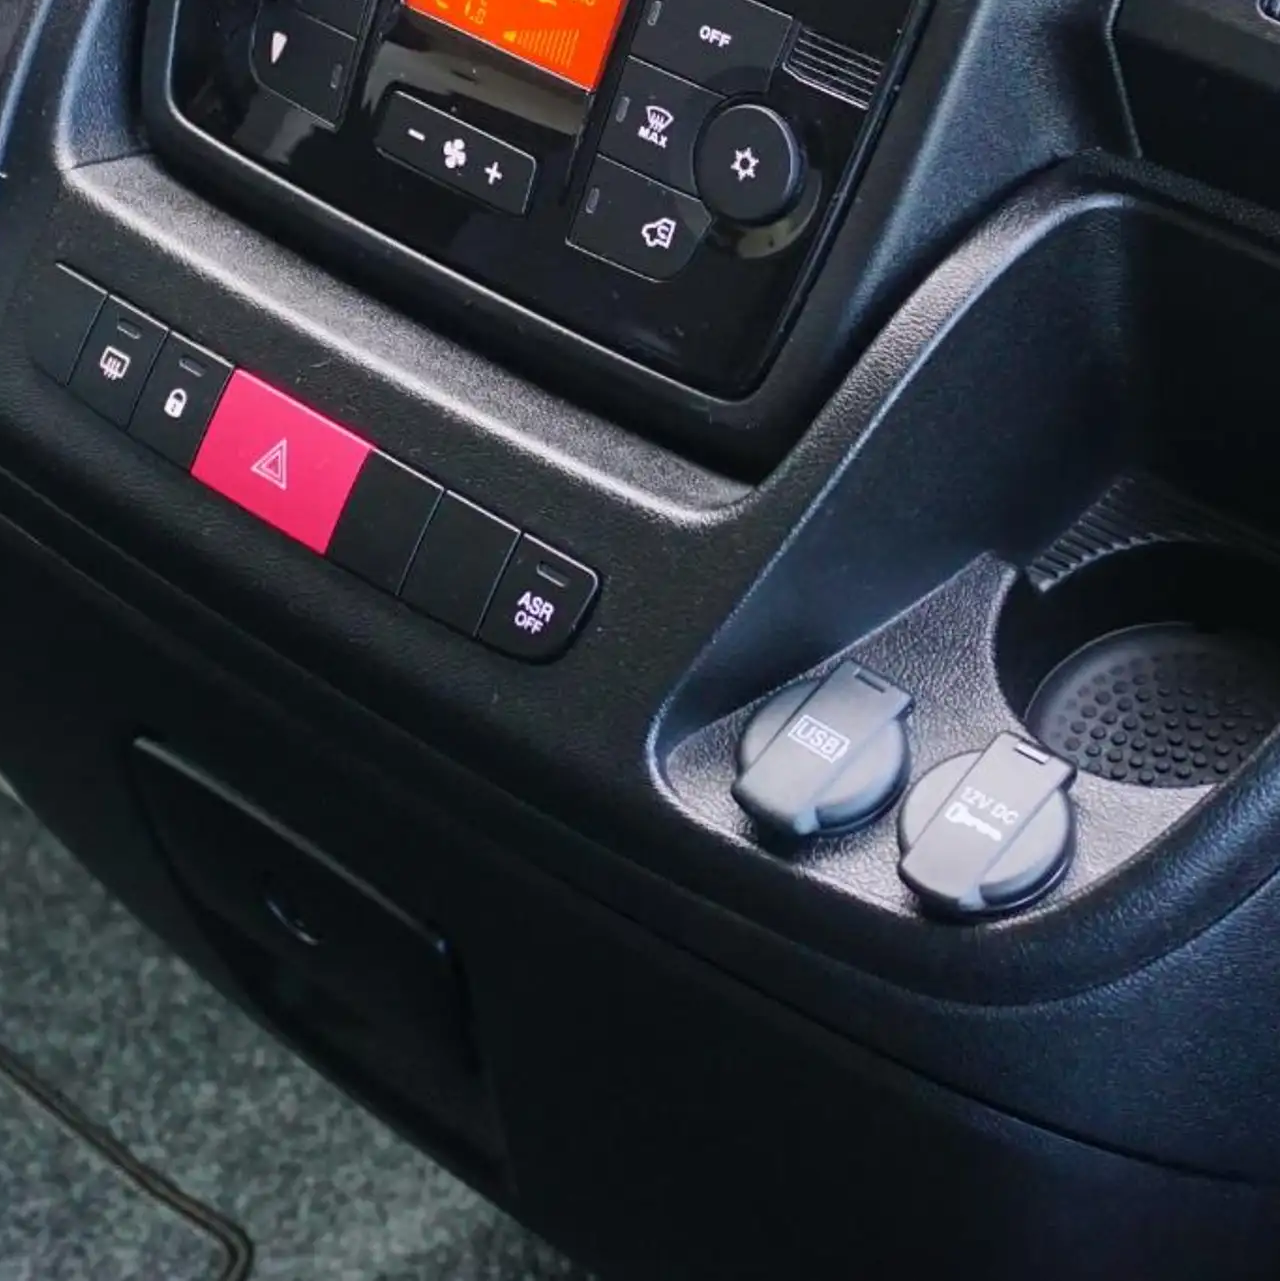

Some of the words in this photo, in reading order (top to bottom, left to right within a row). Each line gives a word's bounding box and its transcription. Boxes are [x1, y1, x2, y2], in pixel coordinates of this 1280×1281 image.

[699, 24, 732, 47] OFF
[637, 125, 668, 149] MAX
[517, 590, 554, 623] ASR
[514, 610, 544, 635] OFF
[796, 721, 840, 754] USB
[960, 786, 995, 809] 12V
[990, 803, 1019, 825] DC
